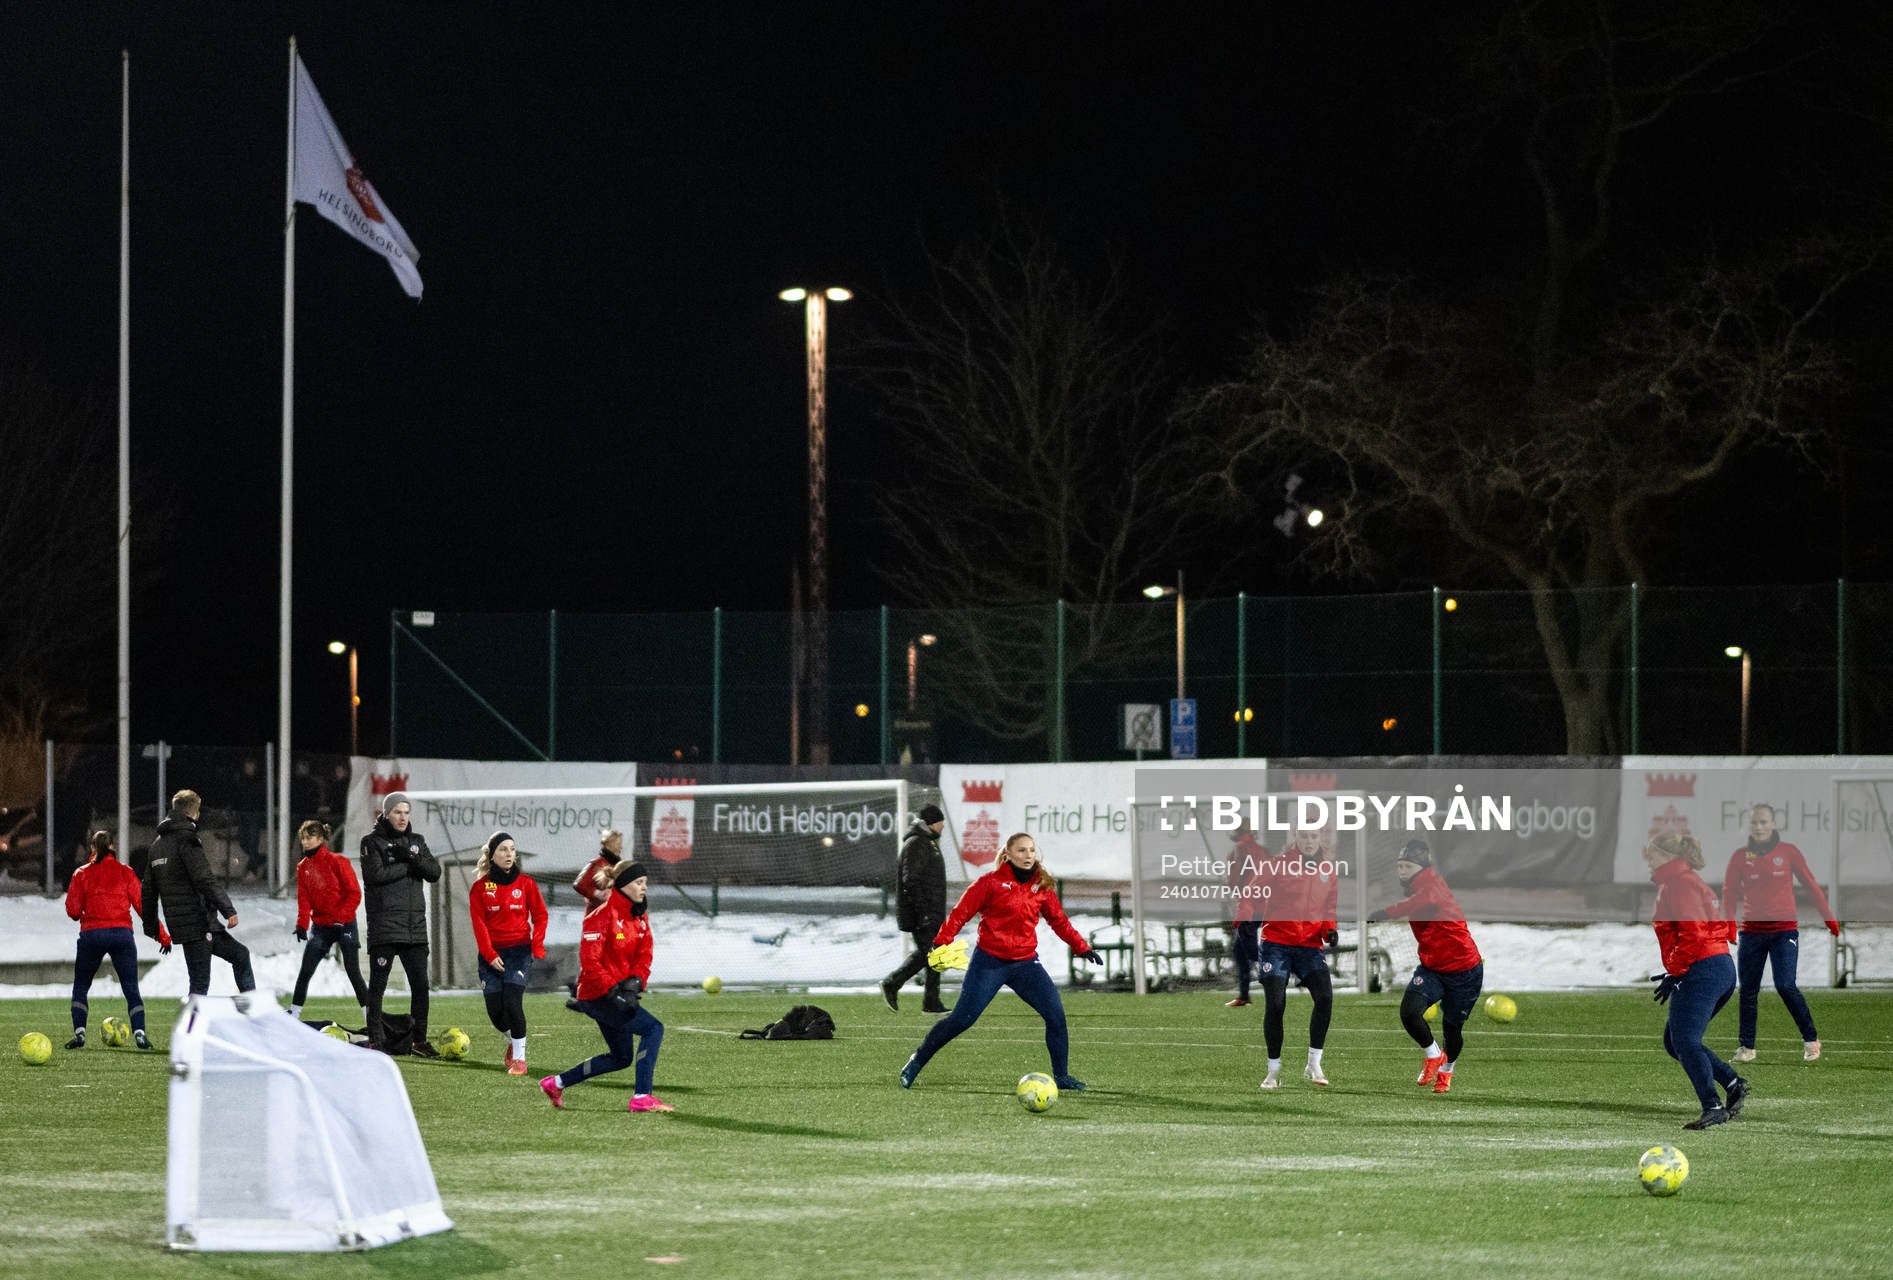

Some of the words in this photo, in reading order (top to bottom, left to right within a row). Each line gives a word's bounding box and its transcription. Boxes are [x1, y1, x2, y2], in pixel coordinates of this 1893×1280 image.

[318, 187, 403, 258] HELSINGBORG
[1177, 702, 1192, 725] P
[481, 799, 613, 835] Helsingborg
[713, 803, 772, 833] Fritid
[1024, 804, 1082, 833] Fritid
